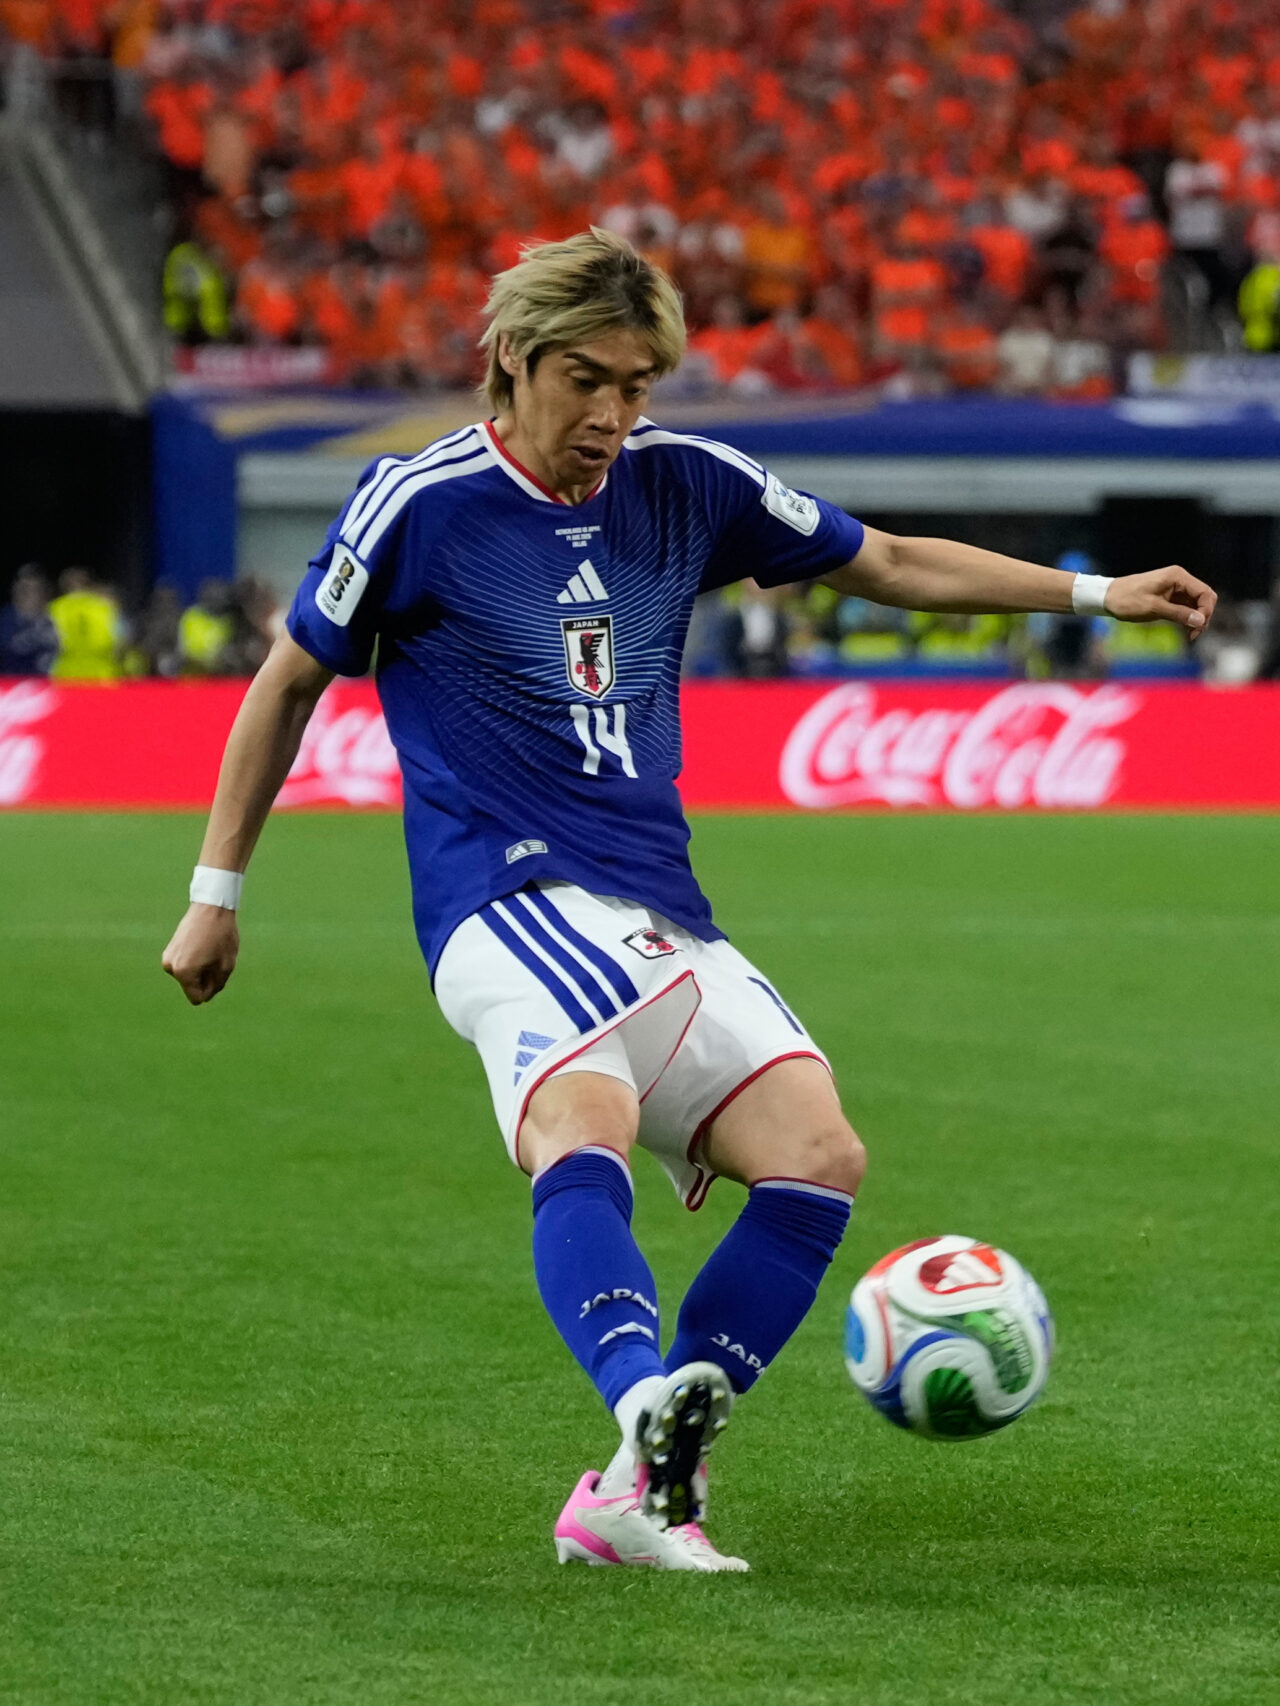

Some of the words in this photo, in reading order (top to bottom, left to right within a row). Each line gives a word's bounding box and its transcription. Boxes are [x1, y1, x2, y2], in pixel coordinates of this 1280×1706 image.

[572, 619, 600, 629] JAPAN
[569, 703, 639, 779] 14
[746, 975, 805, 1036] 1
[579, 1288, 658, 1319] JAPAN
[709, 1332, 766, 1376] JAP
